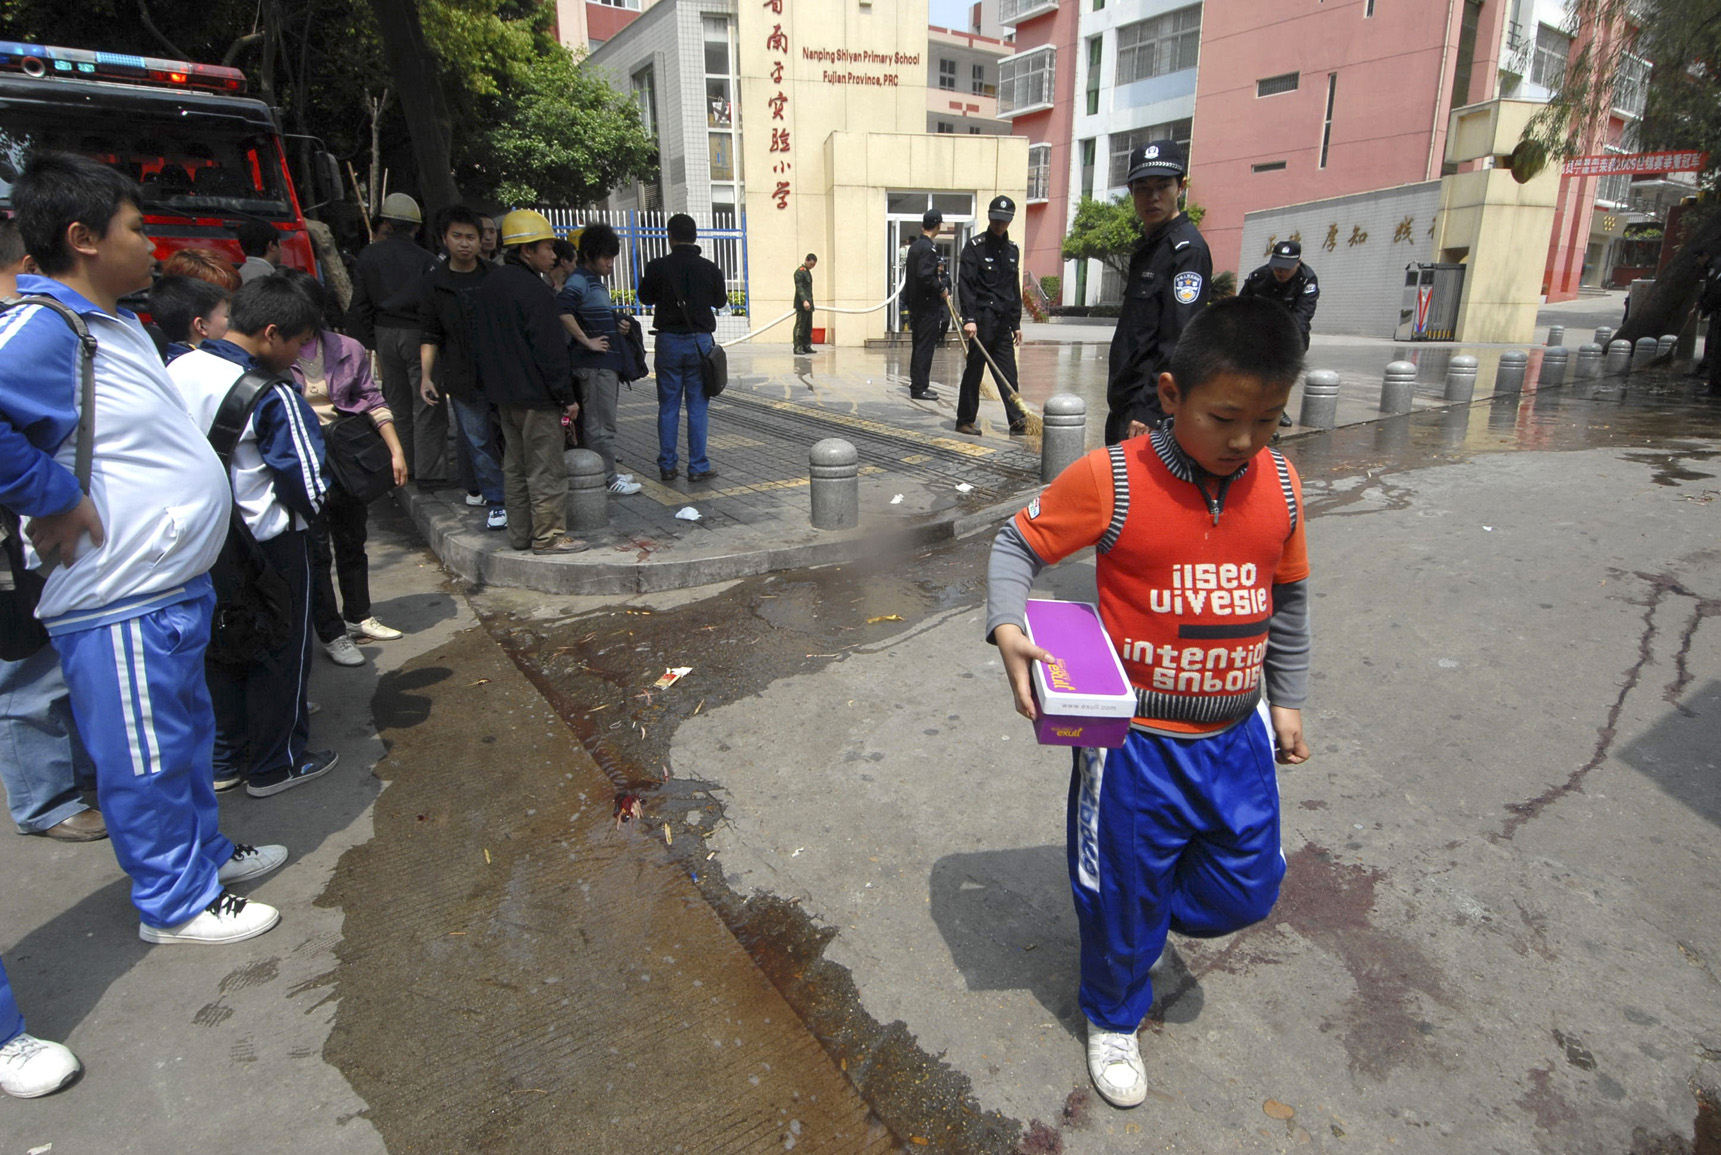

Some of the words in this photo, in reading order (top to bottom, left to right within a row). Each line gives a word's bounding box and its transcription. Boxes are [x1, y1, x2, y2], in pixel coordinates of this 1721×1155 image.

[802, 46, 836, 64] Nanping
[836, 48, 862, 65] Shiyan
[863, 50, 893, 66] Primary
[894, 51, 920, 65] School
[822, 70, 847, 85] Fujian
[847, 71, 882, 87] Province,
[883, 73, 899, 87] PRC
